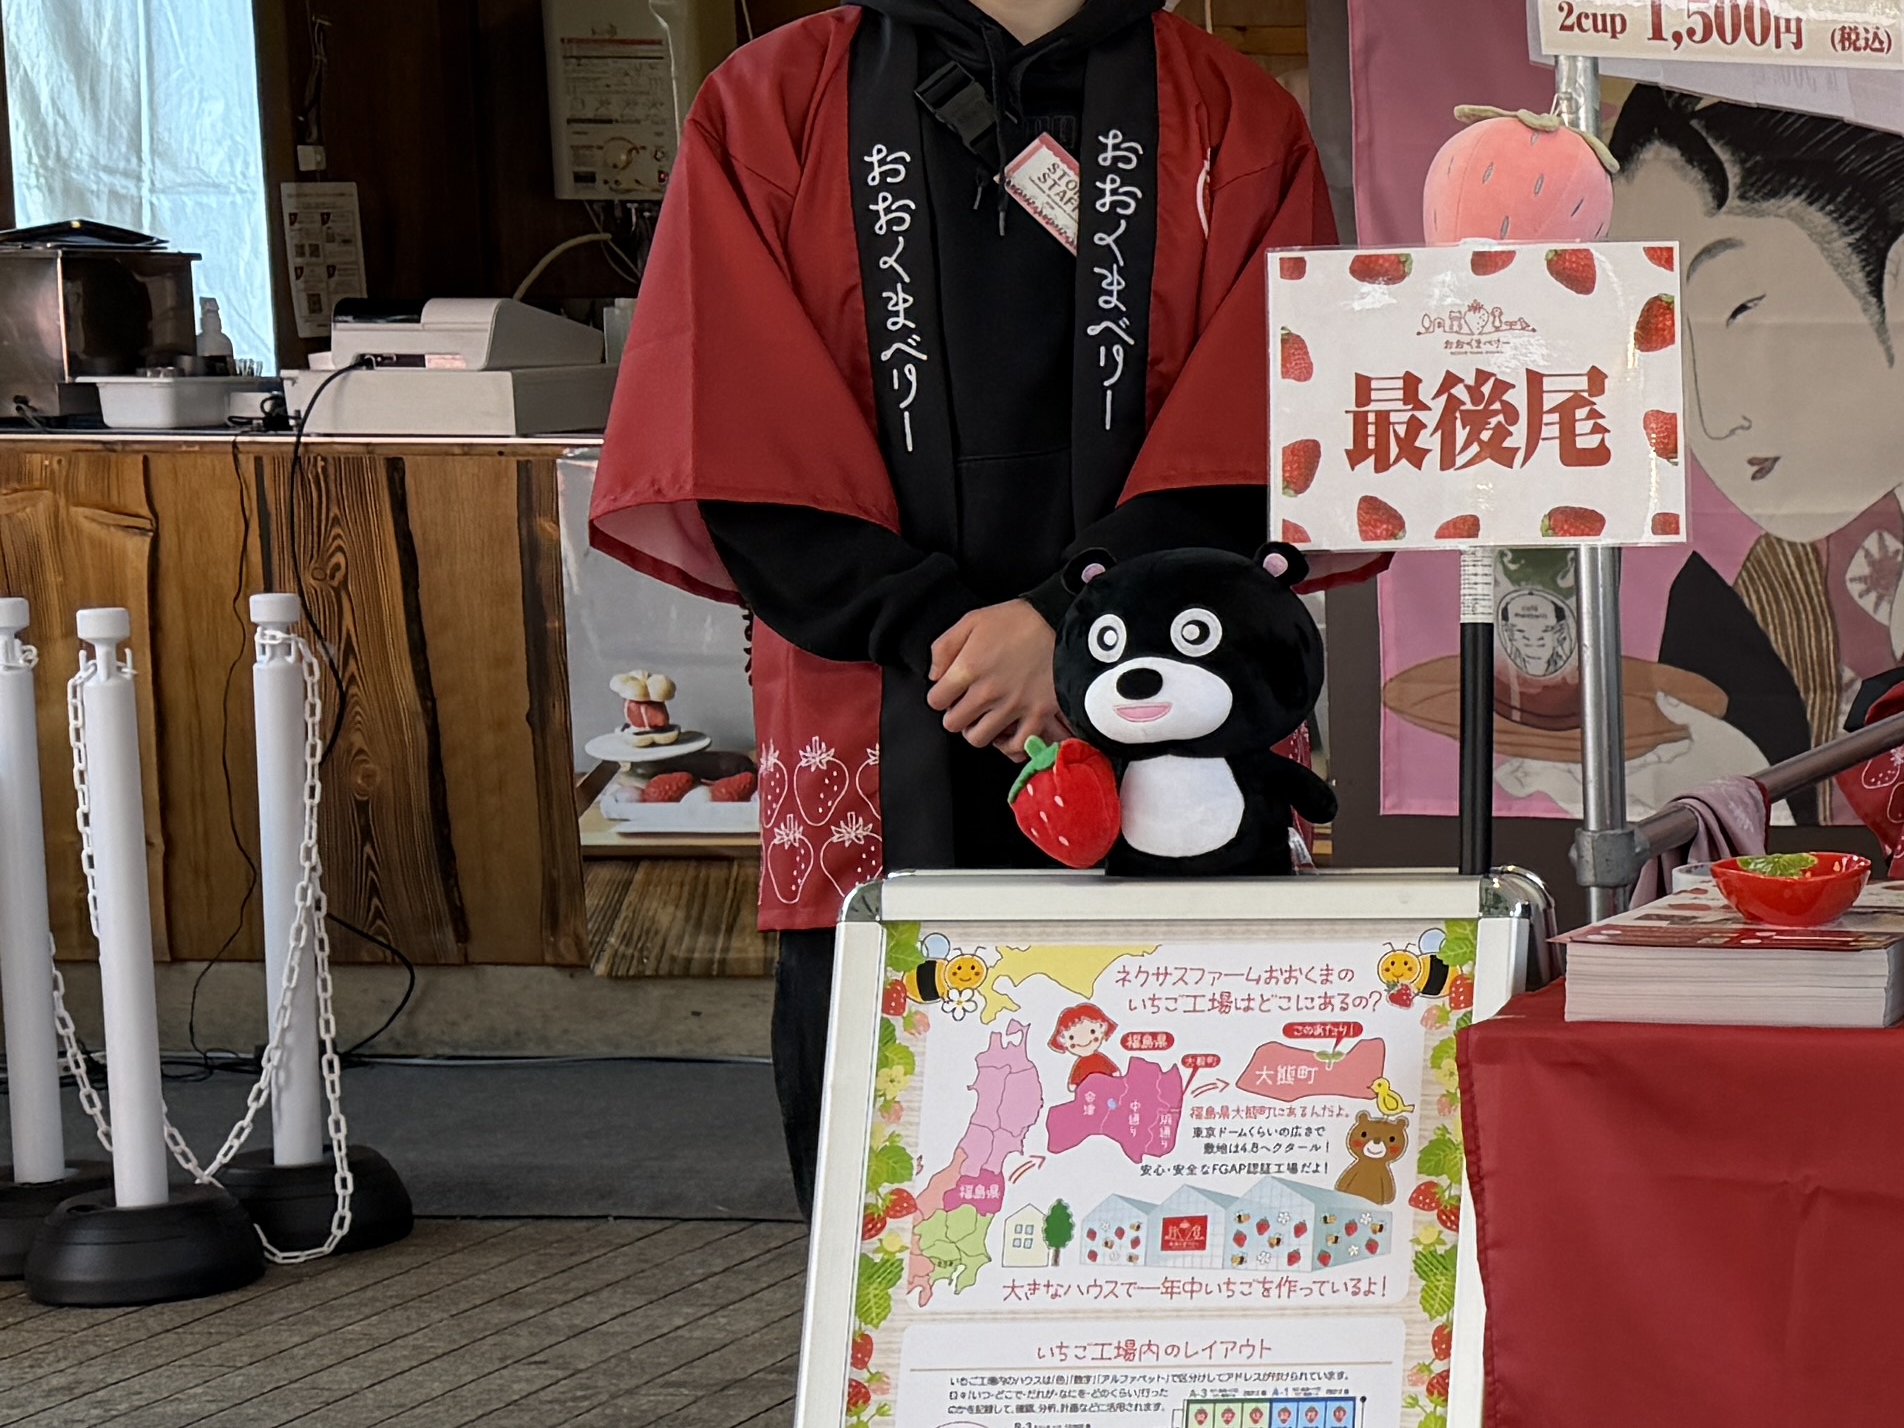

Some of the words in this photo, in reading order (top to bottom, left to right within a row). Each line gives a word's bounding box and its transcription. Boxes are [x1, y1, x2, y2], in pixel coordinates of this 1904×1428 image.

[1557, 0, 1627, 40] 2cup
[1829, 25, 1892, 55] (税込)
[1047, 162, 1080, 197] STO
[1086, 129, 1143, 431] おおくまベリー
[864, 144, 929, 452] おおくまベリー
[1344, 365, 1612, 474] 最後尾
[1115, 964, 1355, 987] ネクサスファームおおくまの
[1128, 991, 1382, 1014] いちご工場はどこにあるの？
[1127, 1035, 1168, 1049] 福島県
[1256, 1066, 1318, 1086] 大熊町
[1192, 1126, 1326, 1139] 東京ドームくらいの広さで
[1036, 1338, 1273, 1364] いちご工場内のレイアウト
